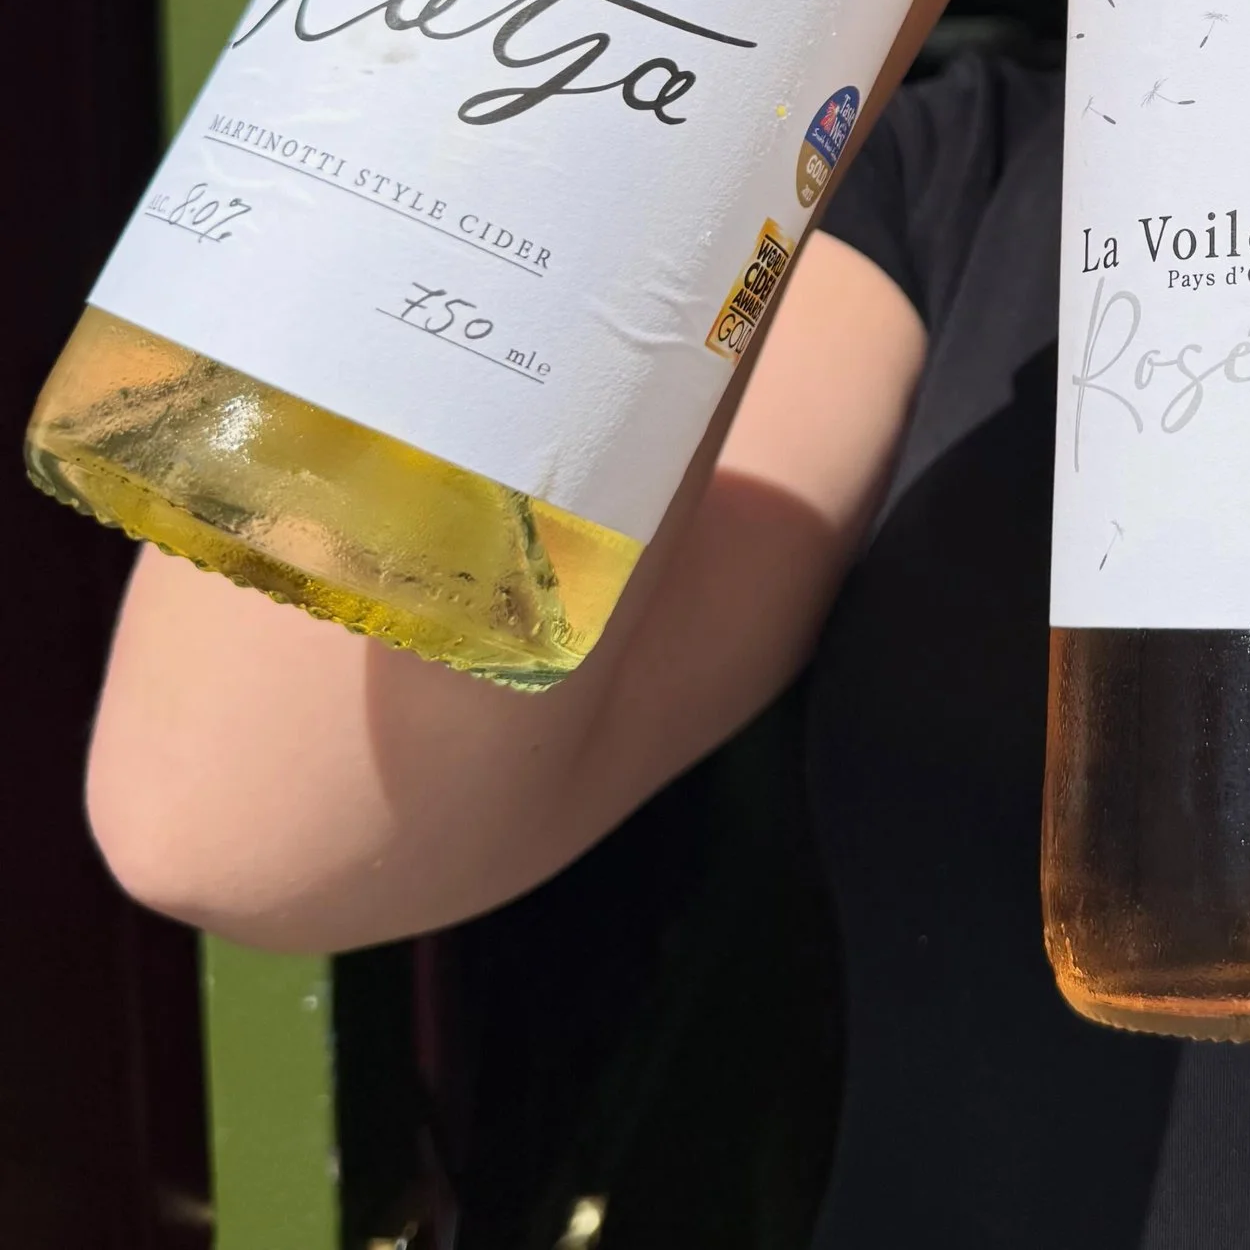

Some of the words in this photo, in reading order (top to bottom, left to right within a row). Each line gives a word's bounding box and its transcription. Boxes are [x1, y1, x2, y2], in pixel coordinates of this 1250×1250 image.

[208, 113, 348, 177] MARTINOTTI
[354, 168, 448, 220] STYLE
[459, 213, 553, 270] CIDER
[806, 154, 828, 186] GOLD
[757, 239, 788, 278] WORLD
[1082, 227, 1120, 274] La
[1167, 269, 1216, 291] Pays
[401, 282, 494, 340] 750
